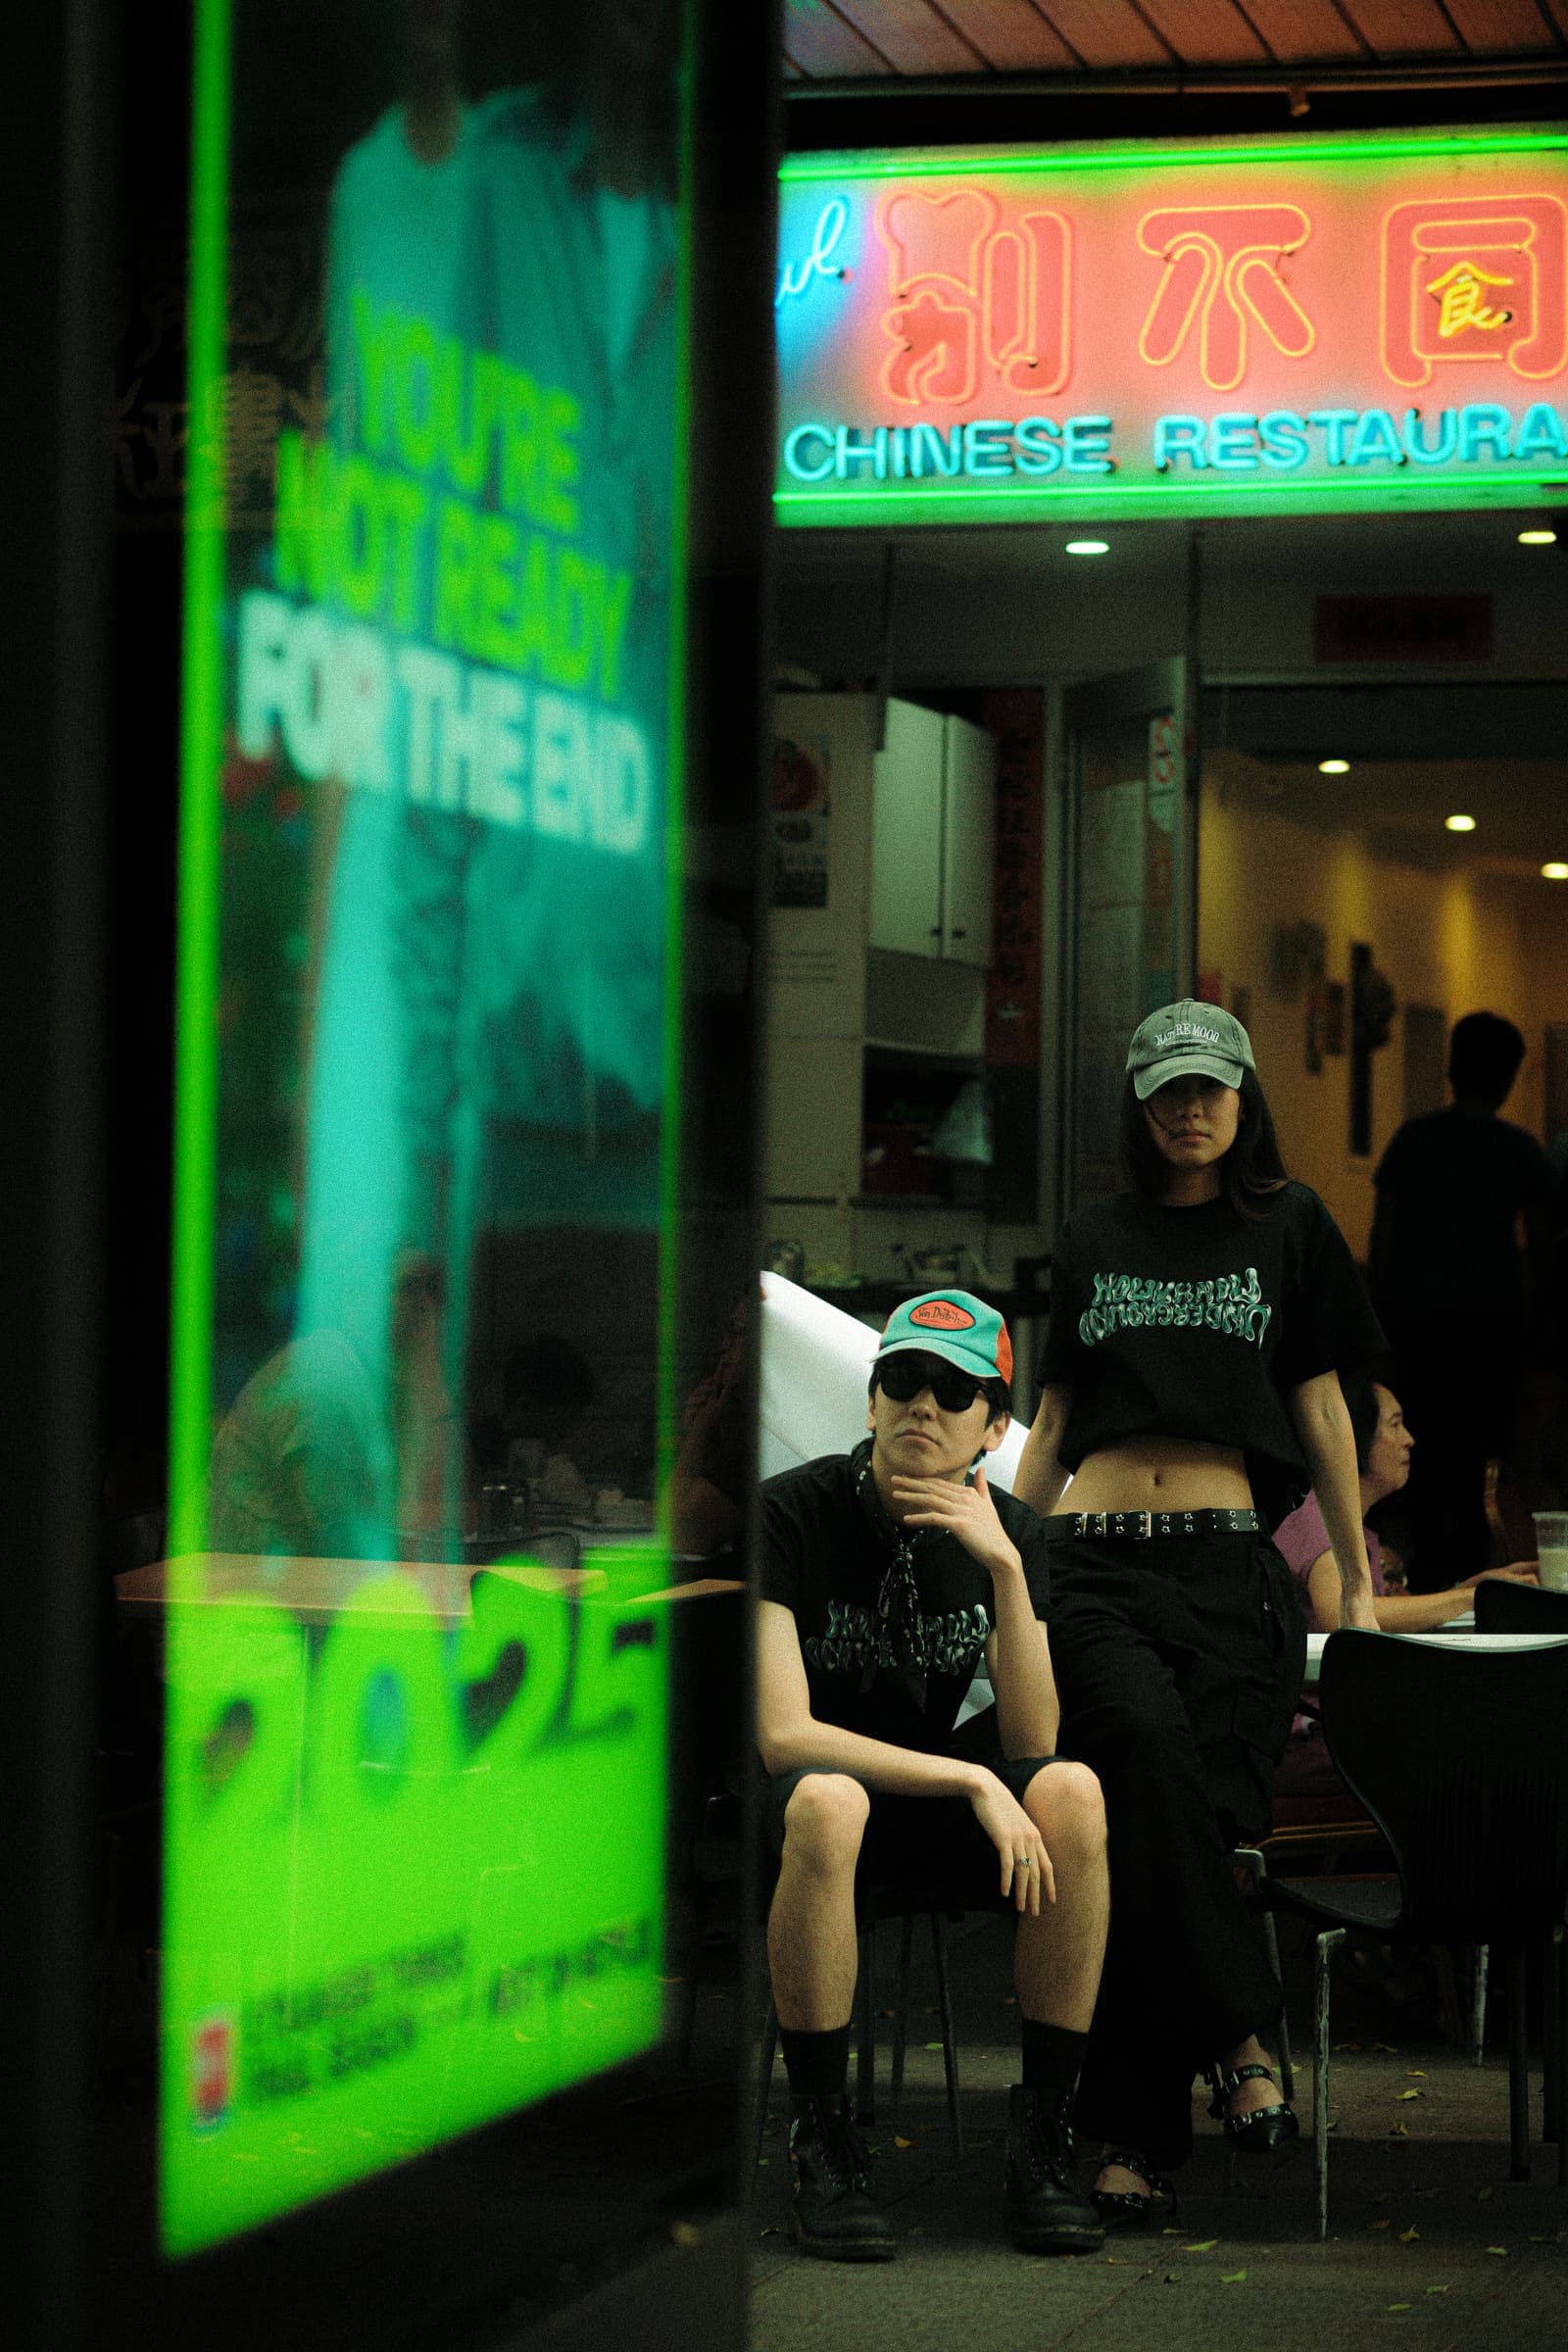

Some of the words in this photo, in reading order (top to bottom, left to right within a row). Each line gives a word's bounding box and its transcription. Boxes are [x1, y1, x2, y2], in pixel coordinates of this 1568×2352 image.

[275, 429, 428, 635] NOT
[433, 493, 635, 702] READY
[785, 416, 1111, 481] CHINESE
[1154, 404, 1568, 472] RESTAURA
[236, 588, 394, 796] FOR
[395, 641, 529, 829] THE
[531, 688, 653, 857] END
